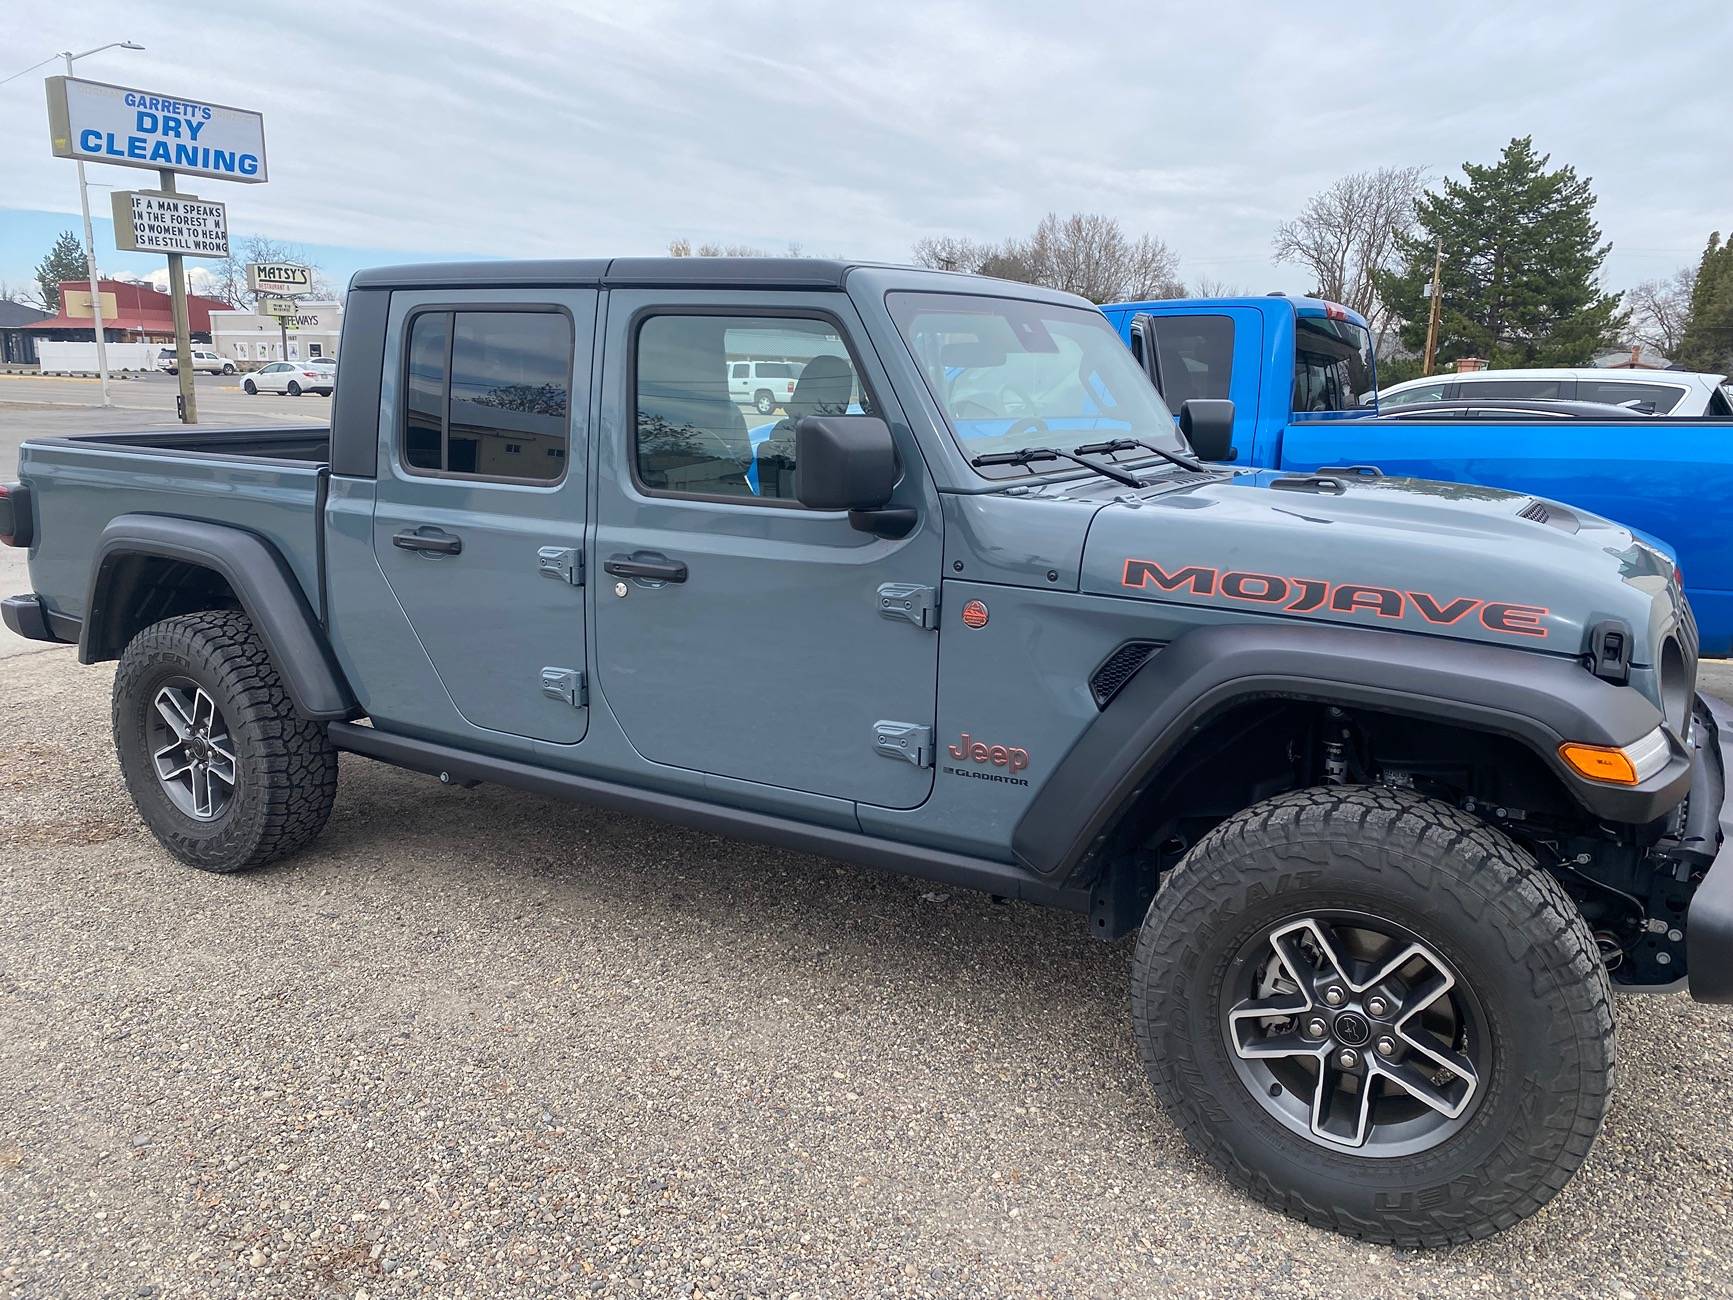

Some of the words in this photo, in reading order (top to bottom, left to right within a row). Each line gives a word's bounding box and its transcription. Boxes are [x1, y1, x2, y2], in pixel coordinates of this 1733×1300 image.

[124, 93, 212, 120] GARRETT'S
[136, 111, 205, 141] DRY
[79, 129, 259, 175] CLEANING
[131, 198, 141, 208] IF
[146, 200, 153, 210] A
[158, 201, 179, 213] MAN
[183, 204, 221, 217] SPEAKS
[133, 210, 143, 220] IN
[146, 211, 166, 223] THE
[170, 214, 207, 227] FOREST
[147, 223, 183, 236] WOMEN
[186, 227, 199, 238] TO
[201, 230, 226, 240] HEAR
[135, 234, 146, 244] IS
[147, 235, 161, 246] HE
[162, 237, 191, 249] STILL
[193, 240, 228, 252] WRONG
[257, 265, 307, 282] MATSY'S
[284, 315, 319, 326] PEWAYS
[1121, 558, 1549, 638] MOJAVE
[947, 731, 1029, 774] Jeep
[955, 768, 1029, 787] GLADIATOR
